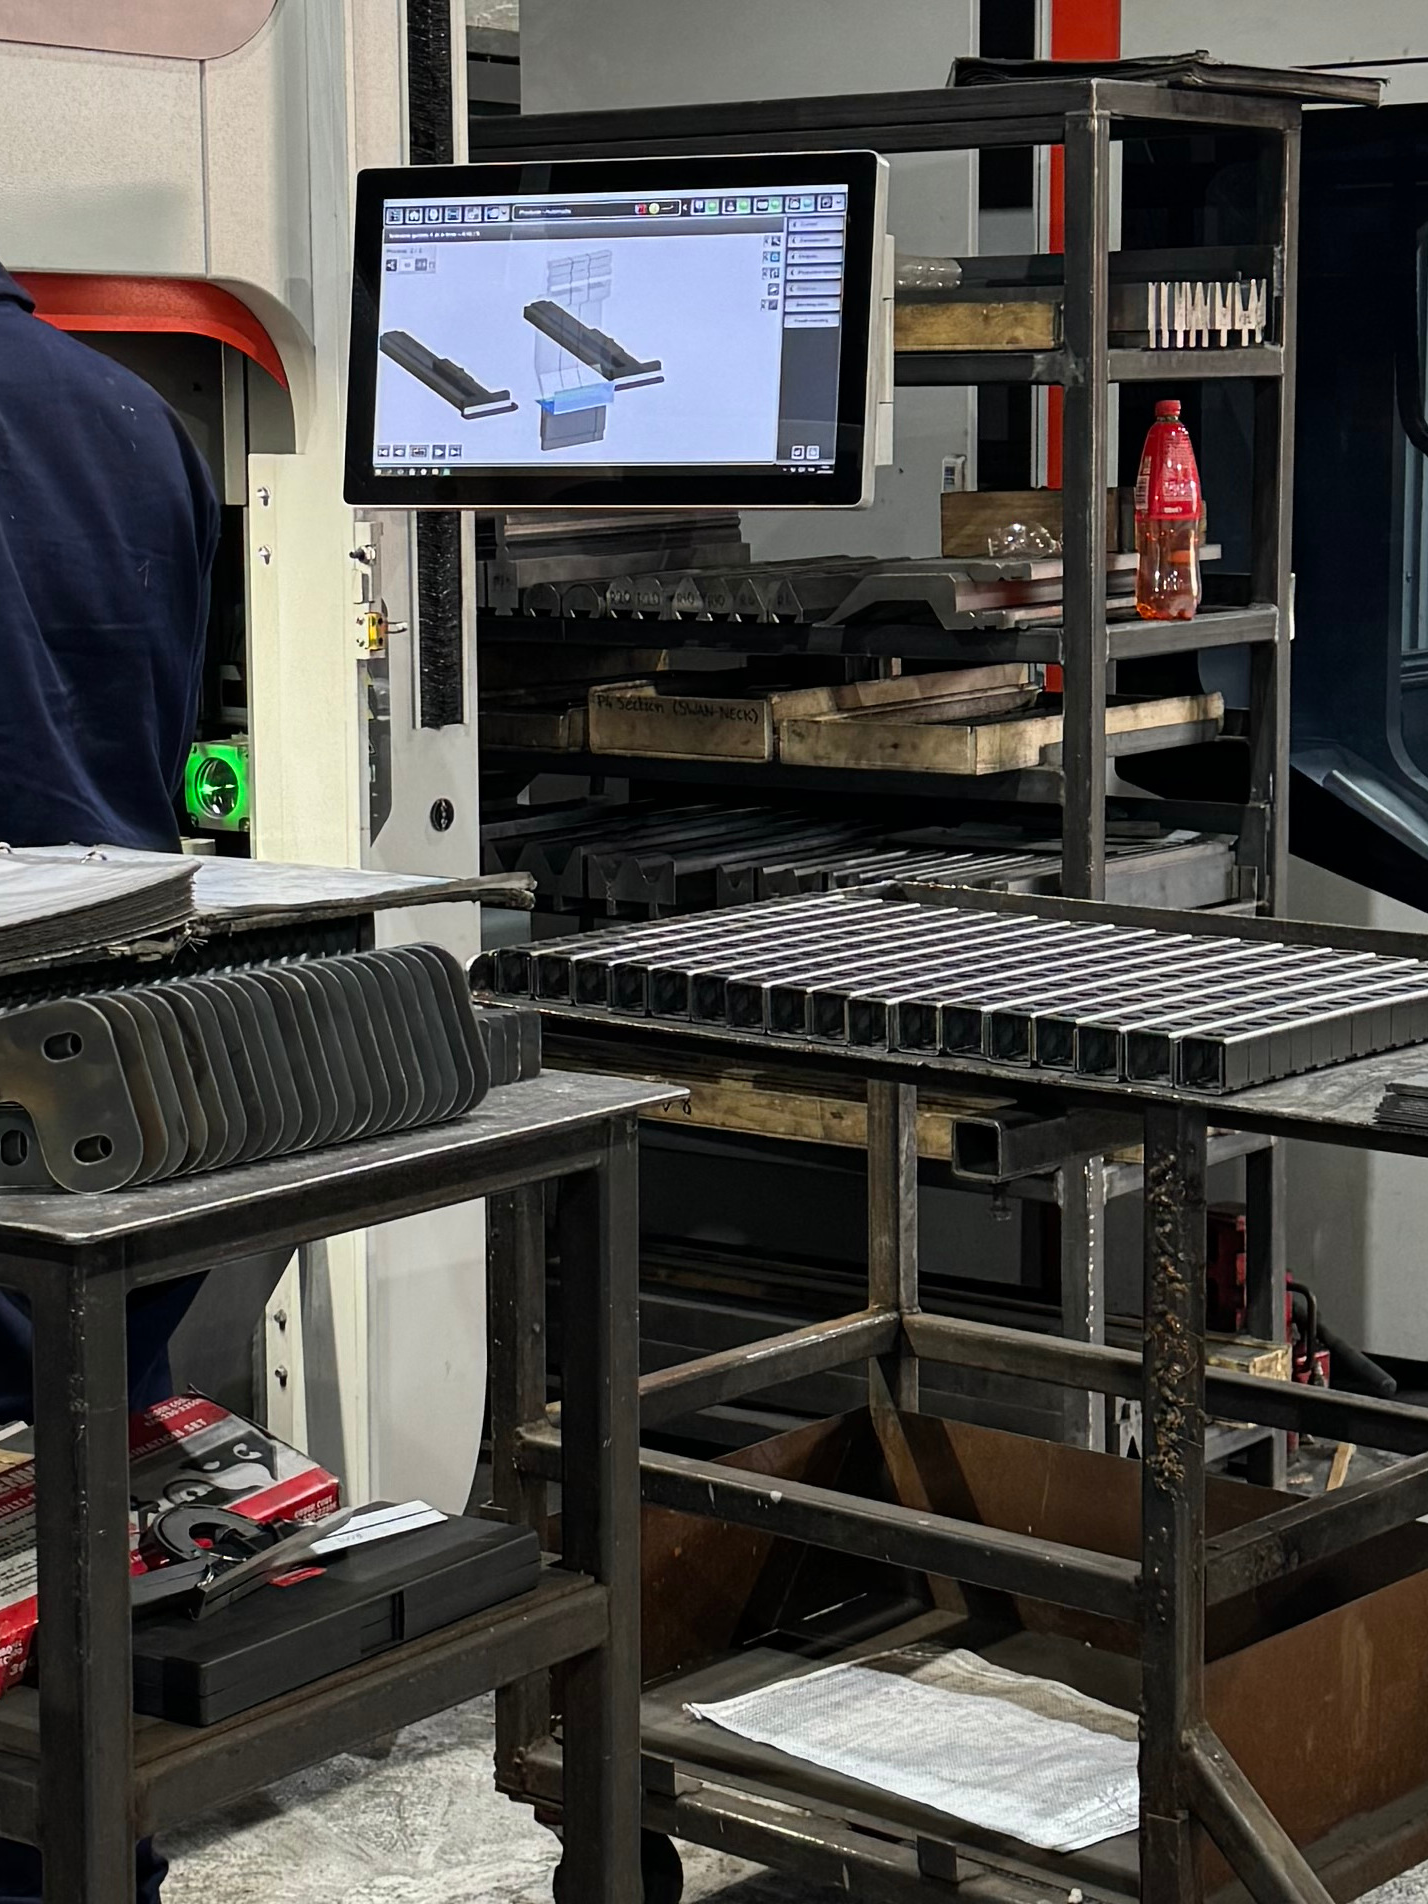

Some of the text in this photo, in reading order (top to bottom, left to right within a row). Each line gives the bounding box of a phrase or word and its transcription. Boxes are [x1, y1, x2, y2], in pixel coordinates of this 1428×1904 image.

[617, 696, 665, 714] Section
[673, 699, 759, 725] (SWAN-NECK)
[183, 1417, 208, 1433] SET
